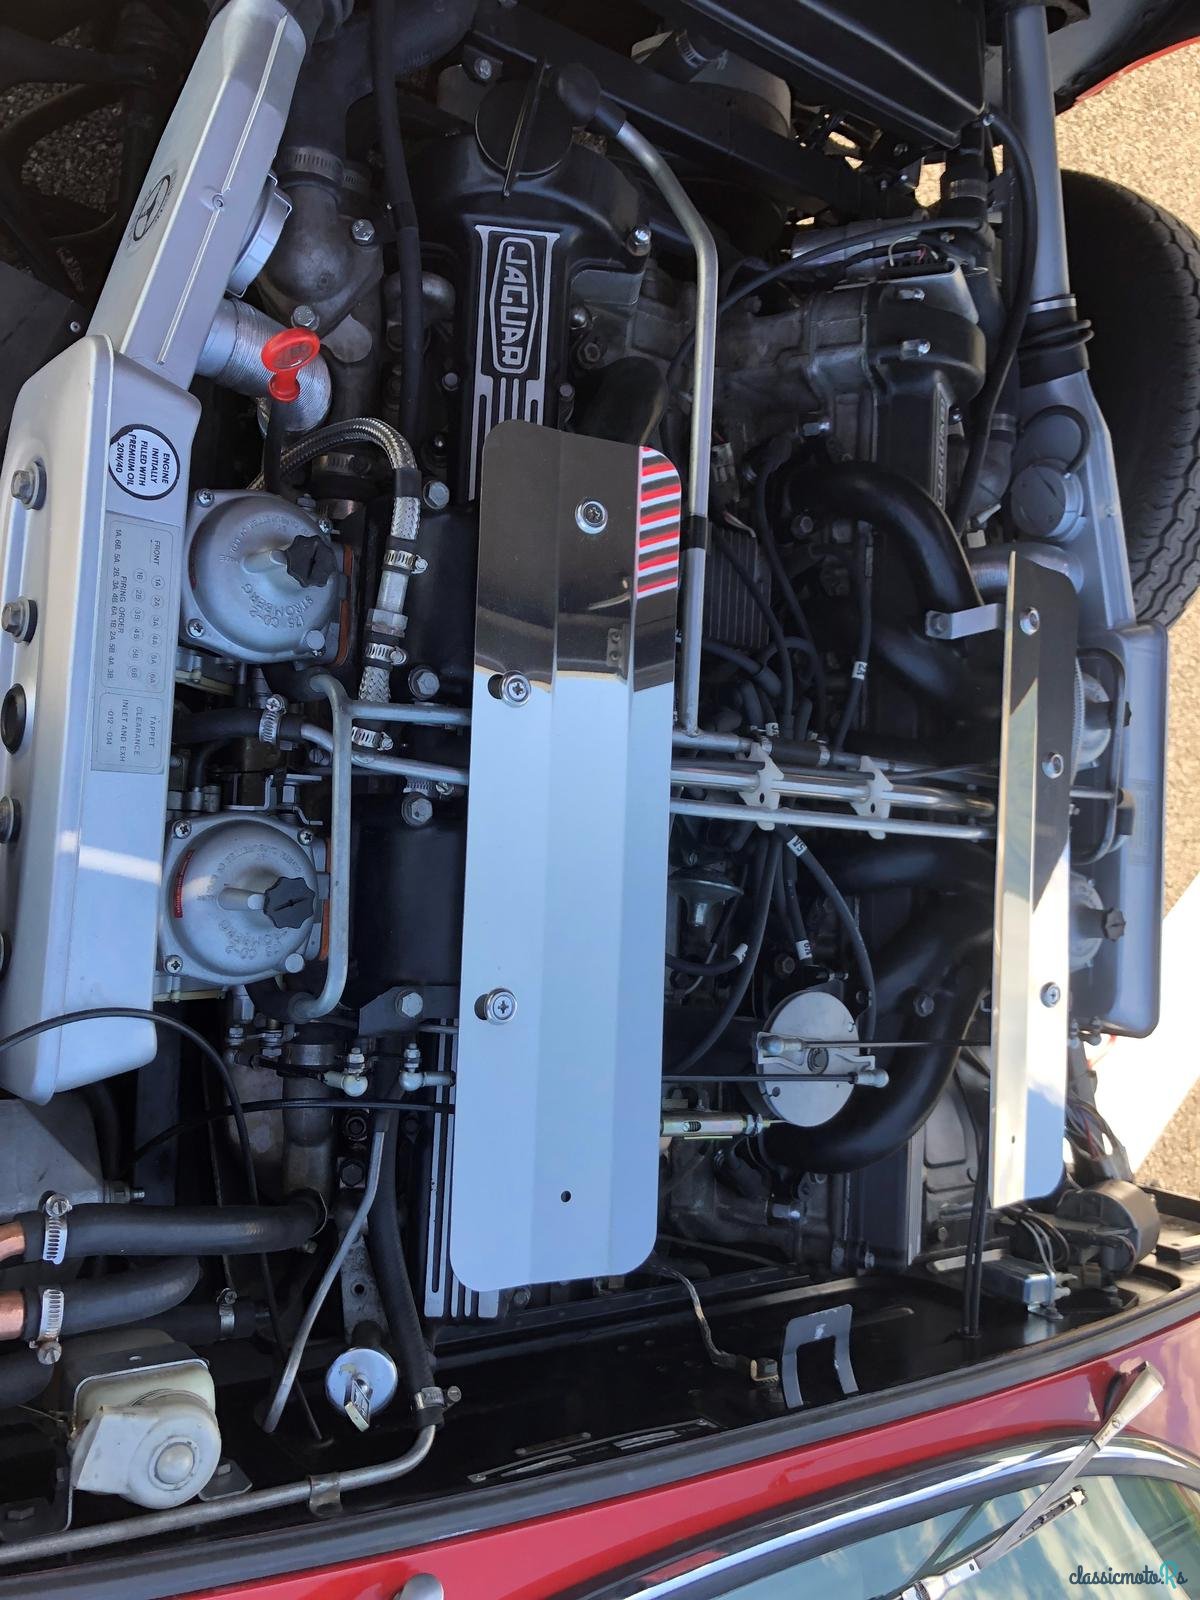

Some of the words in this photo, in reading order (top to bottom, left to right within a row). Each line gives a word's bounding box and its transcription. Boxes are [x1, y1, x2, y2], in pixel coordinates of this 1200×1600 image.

[500, 246, 528, 366] JAGUAR
[115, 442, 125, 473] 20W/40
[140, 440, 148, 465] FILLED
[150, 447, 159, 484] INITIALLY
[126, 473, 135, 486] OIL
[139, 466, 147, 486] WITH
[162, 453, 170, 484] ENGINE
[153, 540, 161, 566] FRONT
[120, 575, 128, 603] FIRING
[117, 606, 126, 634] ORDER
[121, 699, 129, 722] INLET
[133, 706, 143, 757] CLEARANCE
